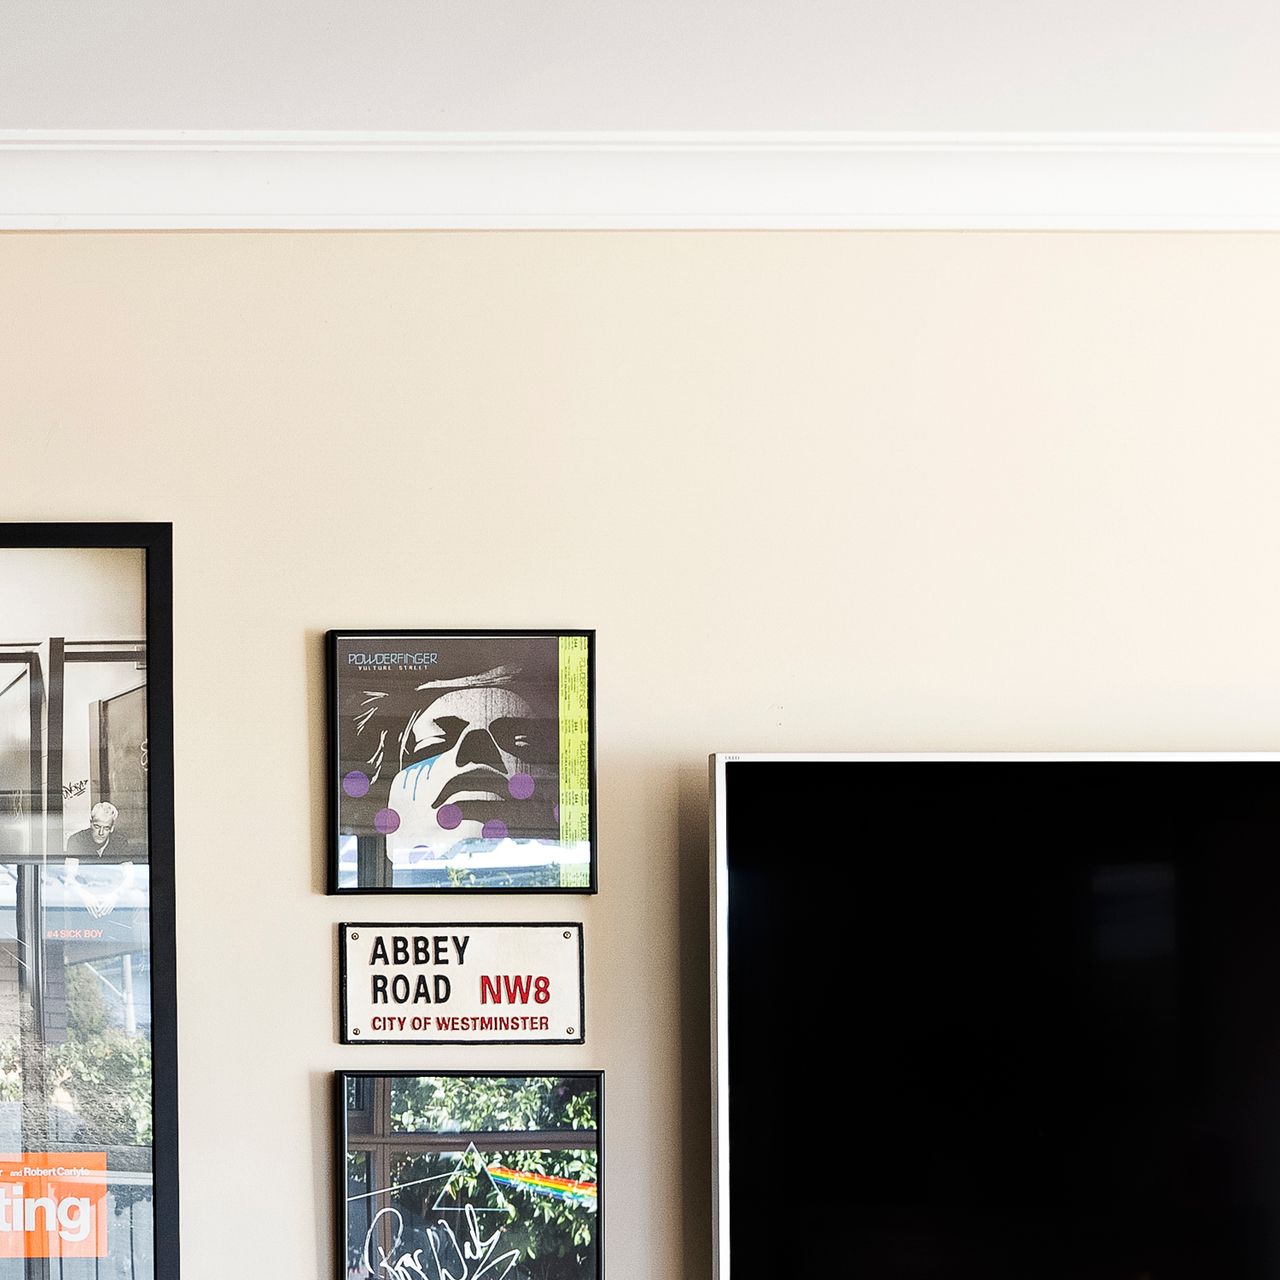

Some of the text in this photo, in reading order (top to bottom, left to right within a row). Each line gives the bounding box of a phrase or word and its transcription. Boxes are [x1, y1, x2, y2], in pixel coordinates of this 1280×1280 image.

[348, 653, 438, 665] POWDERFINGER
[60, 930, 81, 938] SICK
[83, 929, 103, 938] BOY
[370, 935, 470, 966] ABBEY
[372, 974, 551, 1005] ROAD NW8
[371, 1016, 549, 1031] CITY OF WESTMINSTER
[10, 1168, 22, 1177] and
[24, 1167, 57, 1177] Robert
